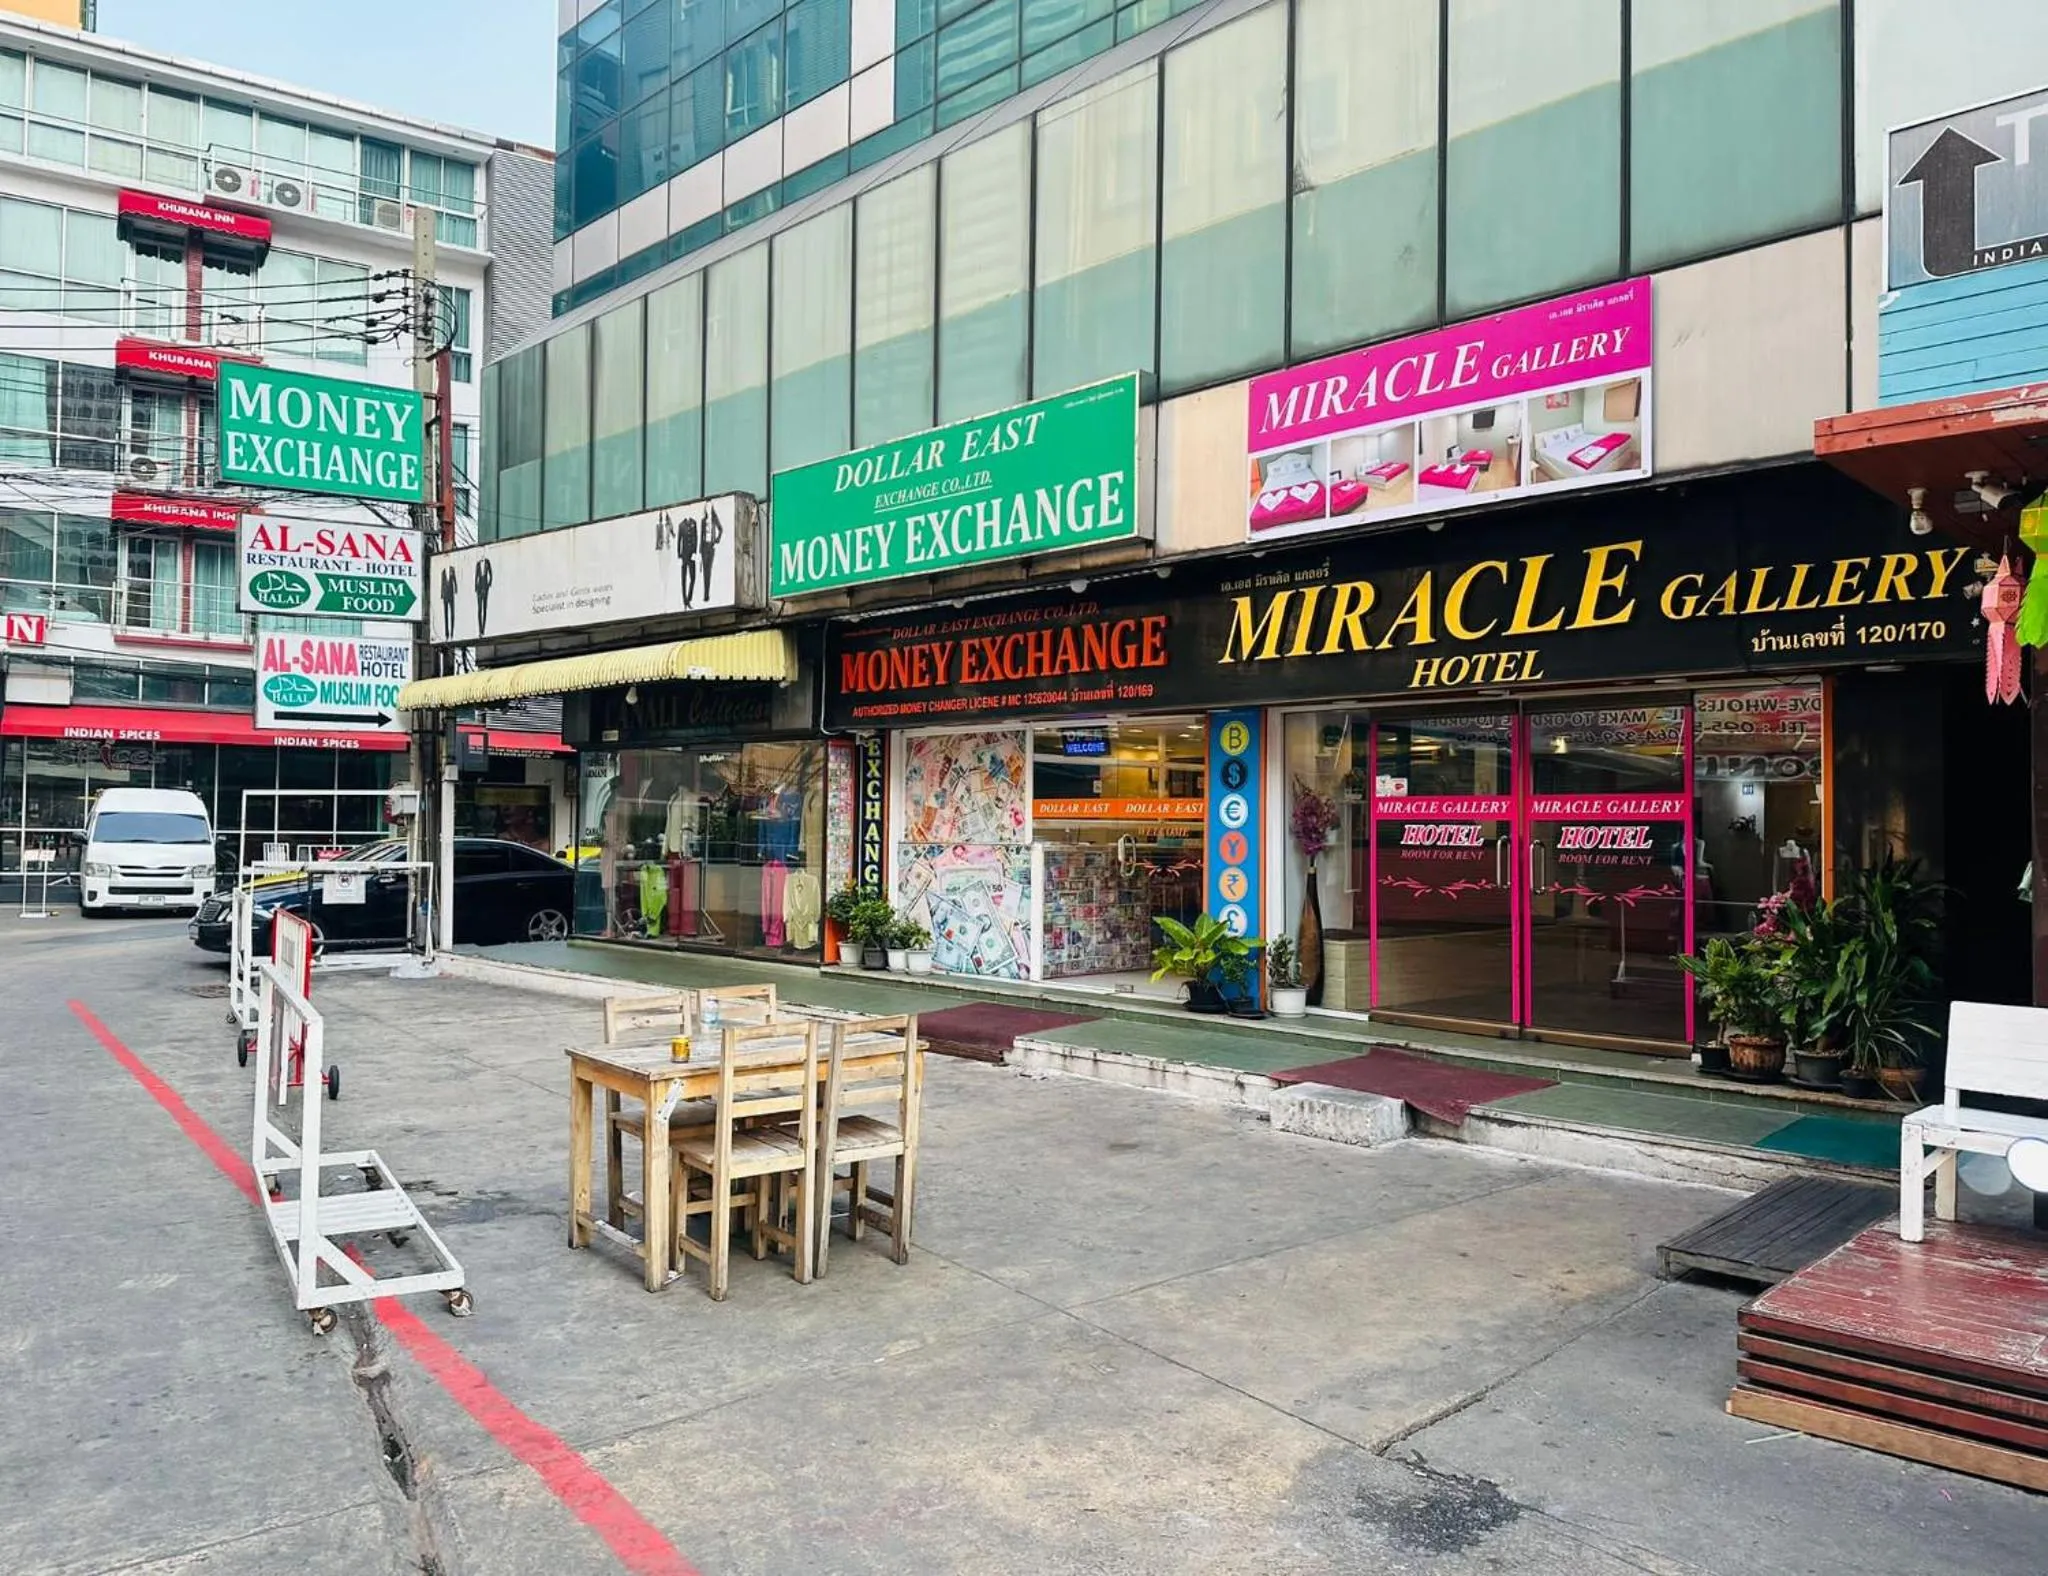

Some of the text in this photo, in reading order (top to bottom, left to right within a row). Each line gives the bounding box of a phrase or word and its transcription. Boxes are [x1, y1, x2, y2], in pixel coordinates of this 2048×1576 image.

[157, 201, 235, 224] KHURANA INN
[1973, 241, 2044, 267] INDIA
[148, 351, 213, 369] KHURANA
[1258, 326, 1632, 434] MIRACLE GALLERY
[228, 377, 414, 443] MONEY
[226, 431, 419, 491] EXCHANGE
[834, 411, 1045, 492] DOLLAR EAST
[874, 481, 939, 509] EXCHANGE
[143, 503, 236, 521] KHURANA INN
[779, 470, 1124, 586] MONEY EXCHANGE
[249, 523, 413, 563] AL-SANA
[246, 553, 352, 573] RESTAURANT
[366, 562, 417, 577] HOTEL
[258, 591, 303, 604] HALAL
[328, 578, 405, 597] MUSLIM
[343, 597, 395, 613] FOOD
[1217, 540, 1971, 664] MIRACLE GALLERY
[10, 615, 40, 642] N
[892, 623, 936, 640] DOLLAR
[941, 619, 970, 633] EAST
[972, 609, 1041, 629] EXCHANGE
[1751, 614, 1946, 652] บ้านเลขที่ 120/170
[263, 638, 358, 676] AL-SANA
[359, 644, 409, 662] RESTAURANT
[840, 614, 1169, 694] MONEY EXCHANGE
[361, 661, 406, 679] HOTEL
[1407, 648, 1546, 689] HOTEL
[320, 681, 400, 707] MUSLIM FOO
[852, 704, 899, 718] AUTHORIZED
[900, 701, 927, 714] MONEY
[928, 698, 967, 712] CHANGER
[64, 728, 160, 740] INDIAN SPICES
[274, 737, 360, 749] INDIAN SPICES
[1066, 742, 1105, 753] WELCOME
[864, 738, 882, 896] EXCHANG
[1039, 803, 1110, 813] DOLLAR EAST
[1125, 803, 1204, 813] DOLLAR EAST
[1376, 801, 1510, 813] MIRACLE GALLERY
[1531, 800, 1684, 814] MIRACLE GALLERY
[1400, 824, 1484, 846] HOTEL
[1557, 825, 1653, 849] HOTEL
[1400, 850, 1484, 860] ROOM FOR RENT
[1558, 854, 1653, 866] ROOM FOR RENT
